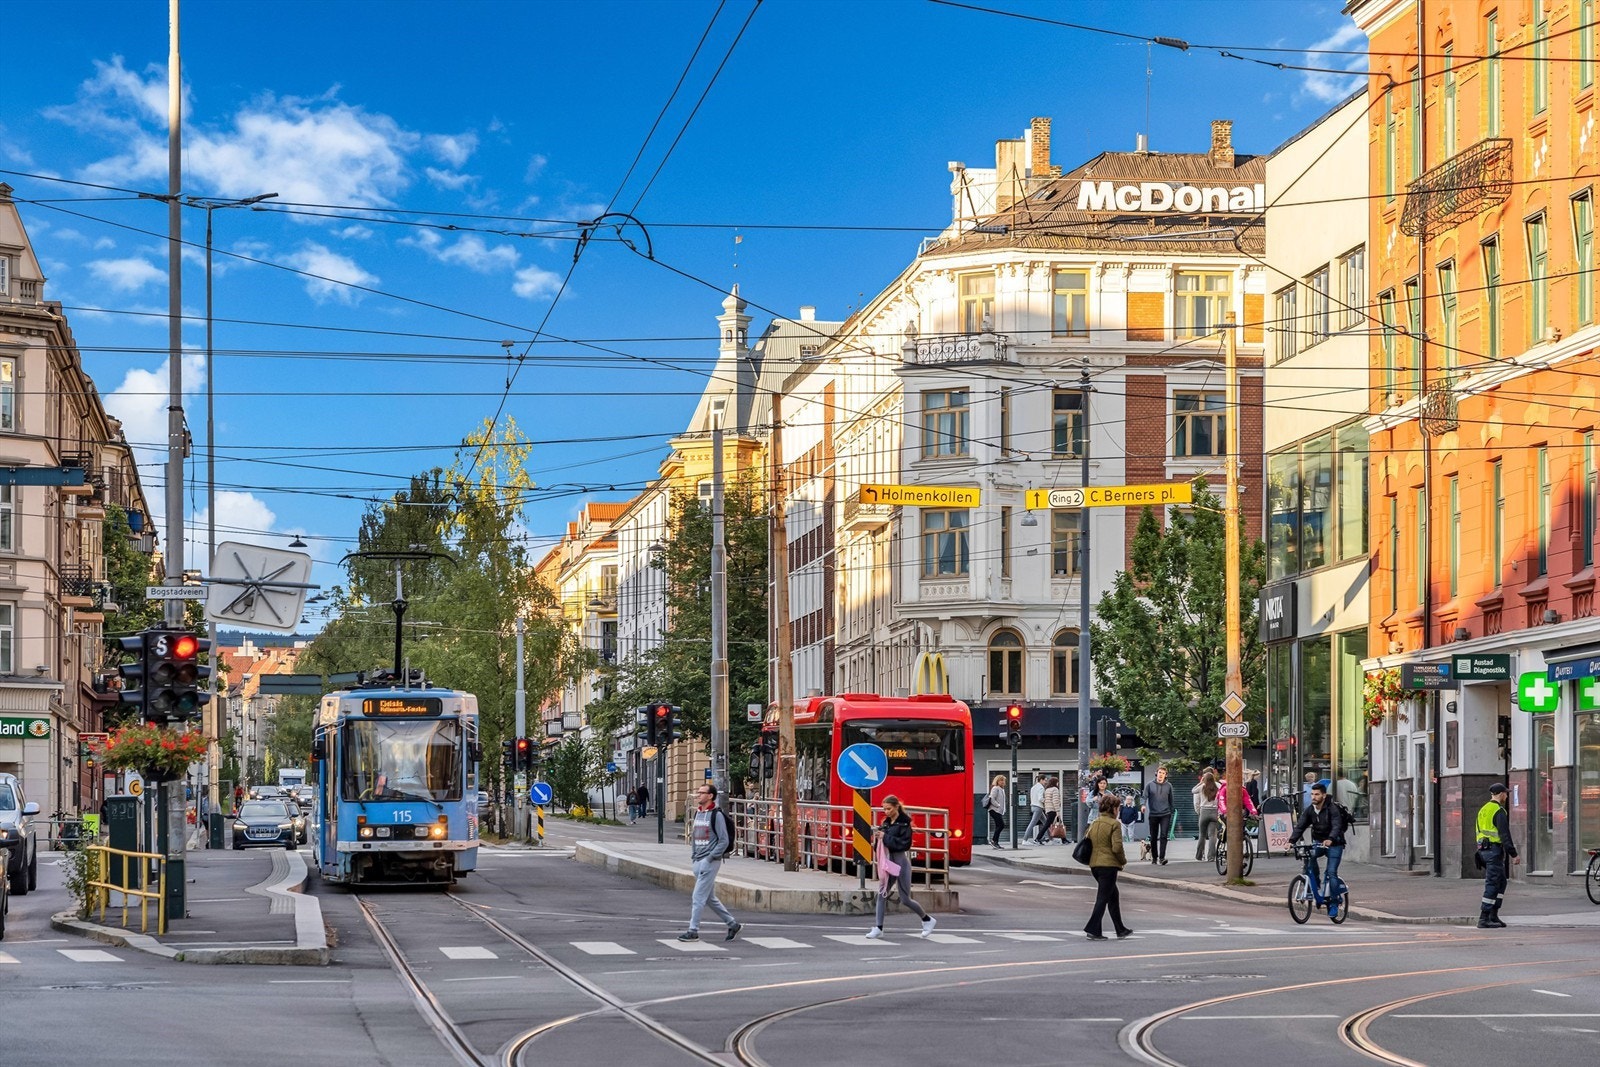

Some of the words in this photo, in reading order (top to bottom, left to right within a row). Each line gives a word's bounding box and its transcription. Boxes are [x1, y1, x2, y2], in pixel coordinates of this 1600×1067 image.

[1077, 181, 1265, 213] McDonal
[881, 488, 973, 503] Holmenkollen
[1052, 494, 1072, 504] Ring
[1073, 493, 1081, 502] 2
[1104, 489, 1155, 502] Berners
[1161, 487, 1175, 501] pl.
[150, 588, 204, 597] Bogstadveien
[156, 636, 168, 656] S
[1473, 666, 1506, 675] Diagnostikk
[1222, 726, 1238, 734] Ring
[1239, 725, 1245, 734] 2
[888, 749, 908, 758] trafikk
[392, 810, 412, 822] 115
